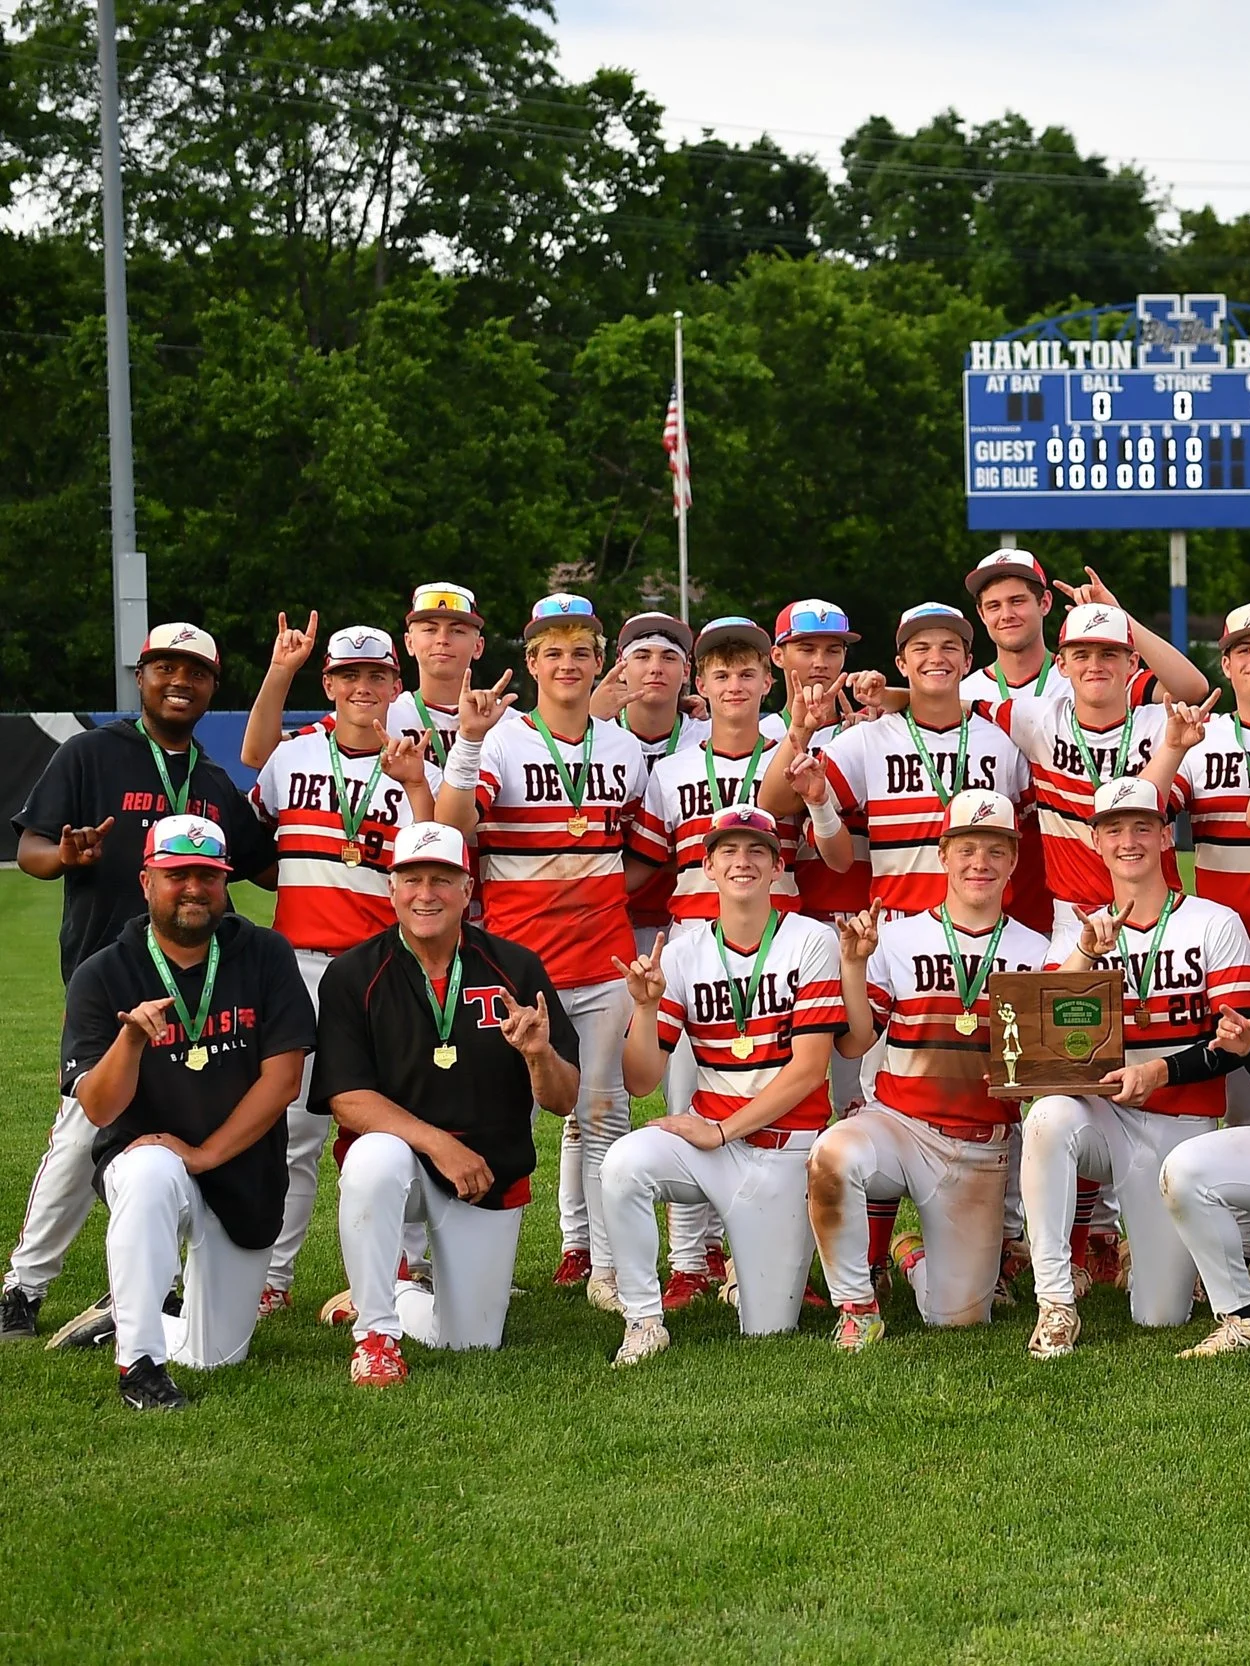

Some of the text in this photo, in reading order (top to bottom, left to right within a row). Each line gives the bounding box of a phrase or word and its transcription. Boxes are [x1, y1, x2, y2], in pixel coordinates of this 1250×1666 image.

[970, 340, 1133, 370] HAMILTON
[985, 374, 1042, 393] AT BAT
[1082, 374, 1123, 392] BALL
[1154, 373, 1212, 392] STRIKE
[1092, 391, 1111, 421] 0
[1173, 391, 1192, 421] 0
[1052, 424, 1060, 438] 1
[1071, 424, 1081, 438] 2
[1094, 424, 1103, 438] 3
[1120, 424, 1130, 438] 4
[1141, 424, 1152, 438] 5
[1162, 424, 1173, 438] 6
[1190, 423, 1199, 437] 7
[1210, 423, 1221, 437] 8
[1231, 423, 1241, 437] 9
[975, 440, 1037, 462] GUEST
[1047, 438, 1063, 463] 0
[1069, 438, 1085, 463] 0
[1099, 439, 1107, 461] 1
[1124, 439, 1133, 461] 1
[1138, 437, 1155, 463] 0
[1168, 439, 1176, 461] 1
[1185, 437, 1202, 463] 0
[975, 466, 1000, 488] BIG
[1002, 466, 1039, 488] BLUE
[1056, 465, 1064, 488] 1
[1069, 464, 1086, 489] 0
[1091, 464, 1107, 489] 0
[1117, 464, 1134, 489] 0
[1139, 464, 1155, 489] 0
[1168, 465, 1176, 488] 1
[1186, 463, 1203, 489] 0
[886, 752, 997, 794] DEVILS
[122, 791, 153, 811] RED
[677, 776, 763, 821] DEVI
[364, 830, 385, 860] 9
[912, 953, 1032, 994] DEV
[463, 985, 502, 1029] T
[1168, 995, 1205, 1027] 20
